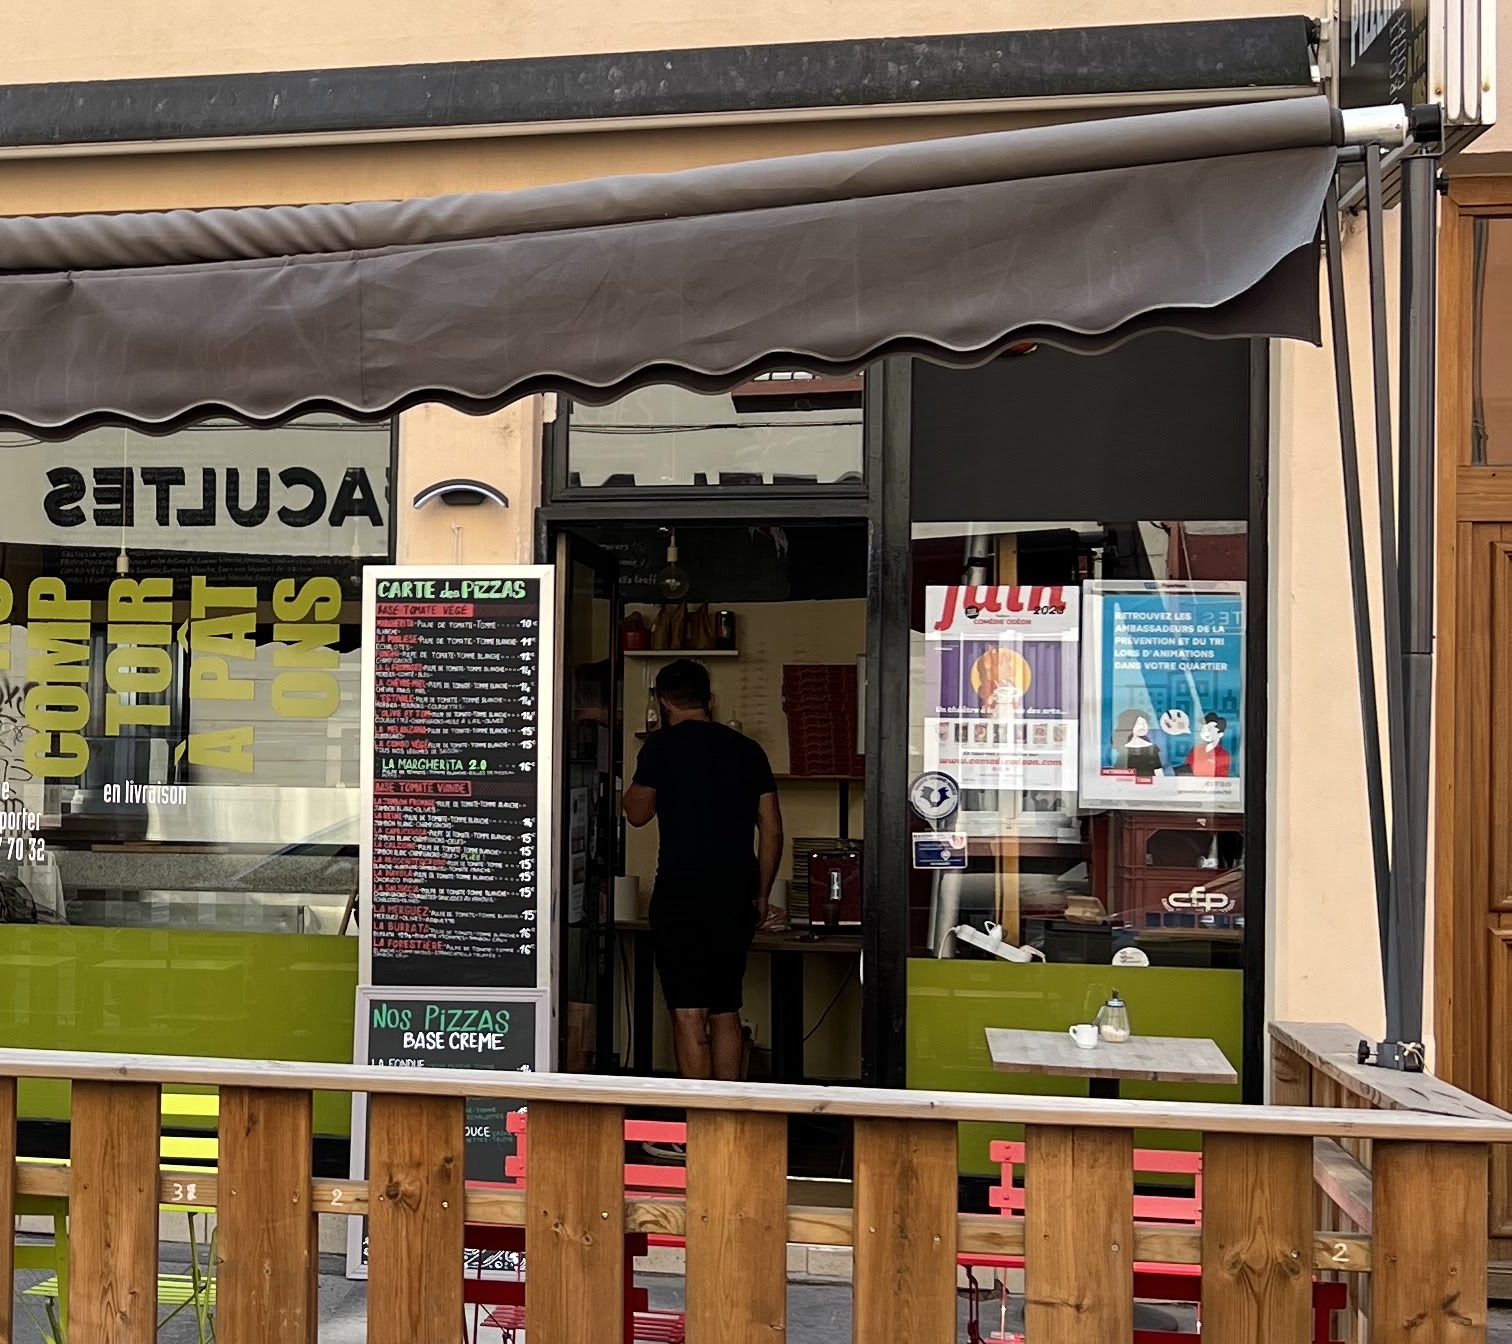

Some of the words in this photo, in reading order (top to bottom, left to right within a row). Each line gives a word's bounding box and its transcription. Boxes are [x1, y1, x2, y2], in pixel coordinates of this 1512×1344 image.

[377, 581, 436, 599] CARTE
[378, 604, 399, 615] BASE
[404, 604, 436, 615] TOMATE
[1114, 612, 1172, 620] RETROUVEZ
[1174, 612, 1192, 621] LES
[1115, 624, 1194, 633] AMBASSADEURS
[1197, 625, 1210, 633] DE
[1212, 625, 1225, 633] LA
[271, 576, 342, 719] ONS
[1178, 637, 1190, 645] ET
[1192, 637, 1206, 645] DU
[1209, 637, 1225, 646] TRI
[106, 577, 173, 736] TOIR
[1114, 662, 1141, 670] DANS
[1144, 662, 1176, 670] VOTRE
[1178, 662, 1228, 671] QUARTIER
[24, 576, 91, 778] COMP
[382, 758, 395, 769] LA
[469, 759, 487, 770] 2.0
[103, 783, 121, 803] en
[125, 779, 187, 805] livraison
[399, 782, 434, 793] TOMATE
[7, 837, 24, 861] 70
[28, 837, 46, 862] 32
[403, 1031, 445, 1050] BASE
[448, 1032, 506, 1052] CREME
[331, 1189, 344, 1206] 2
[1331, 1242, 1350, 1263] 2
